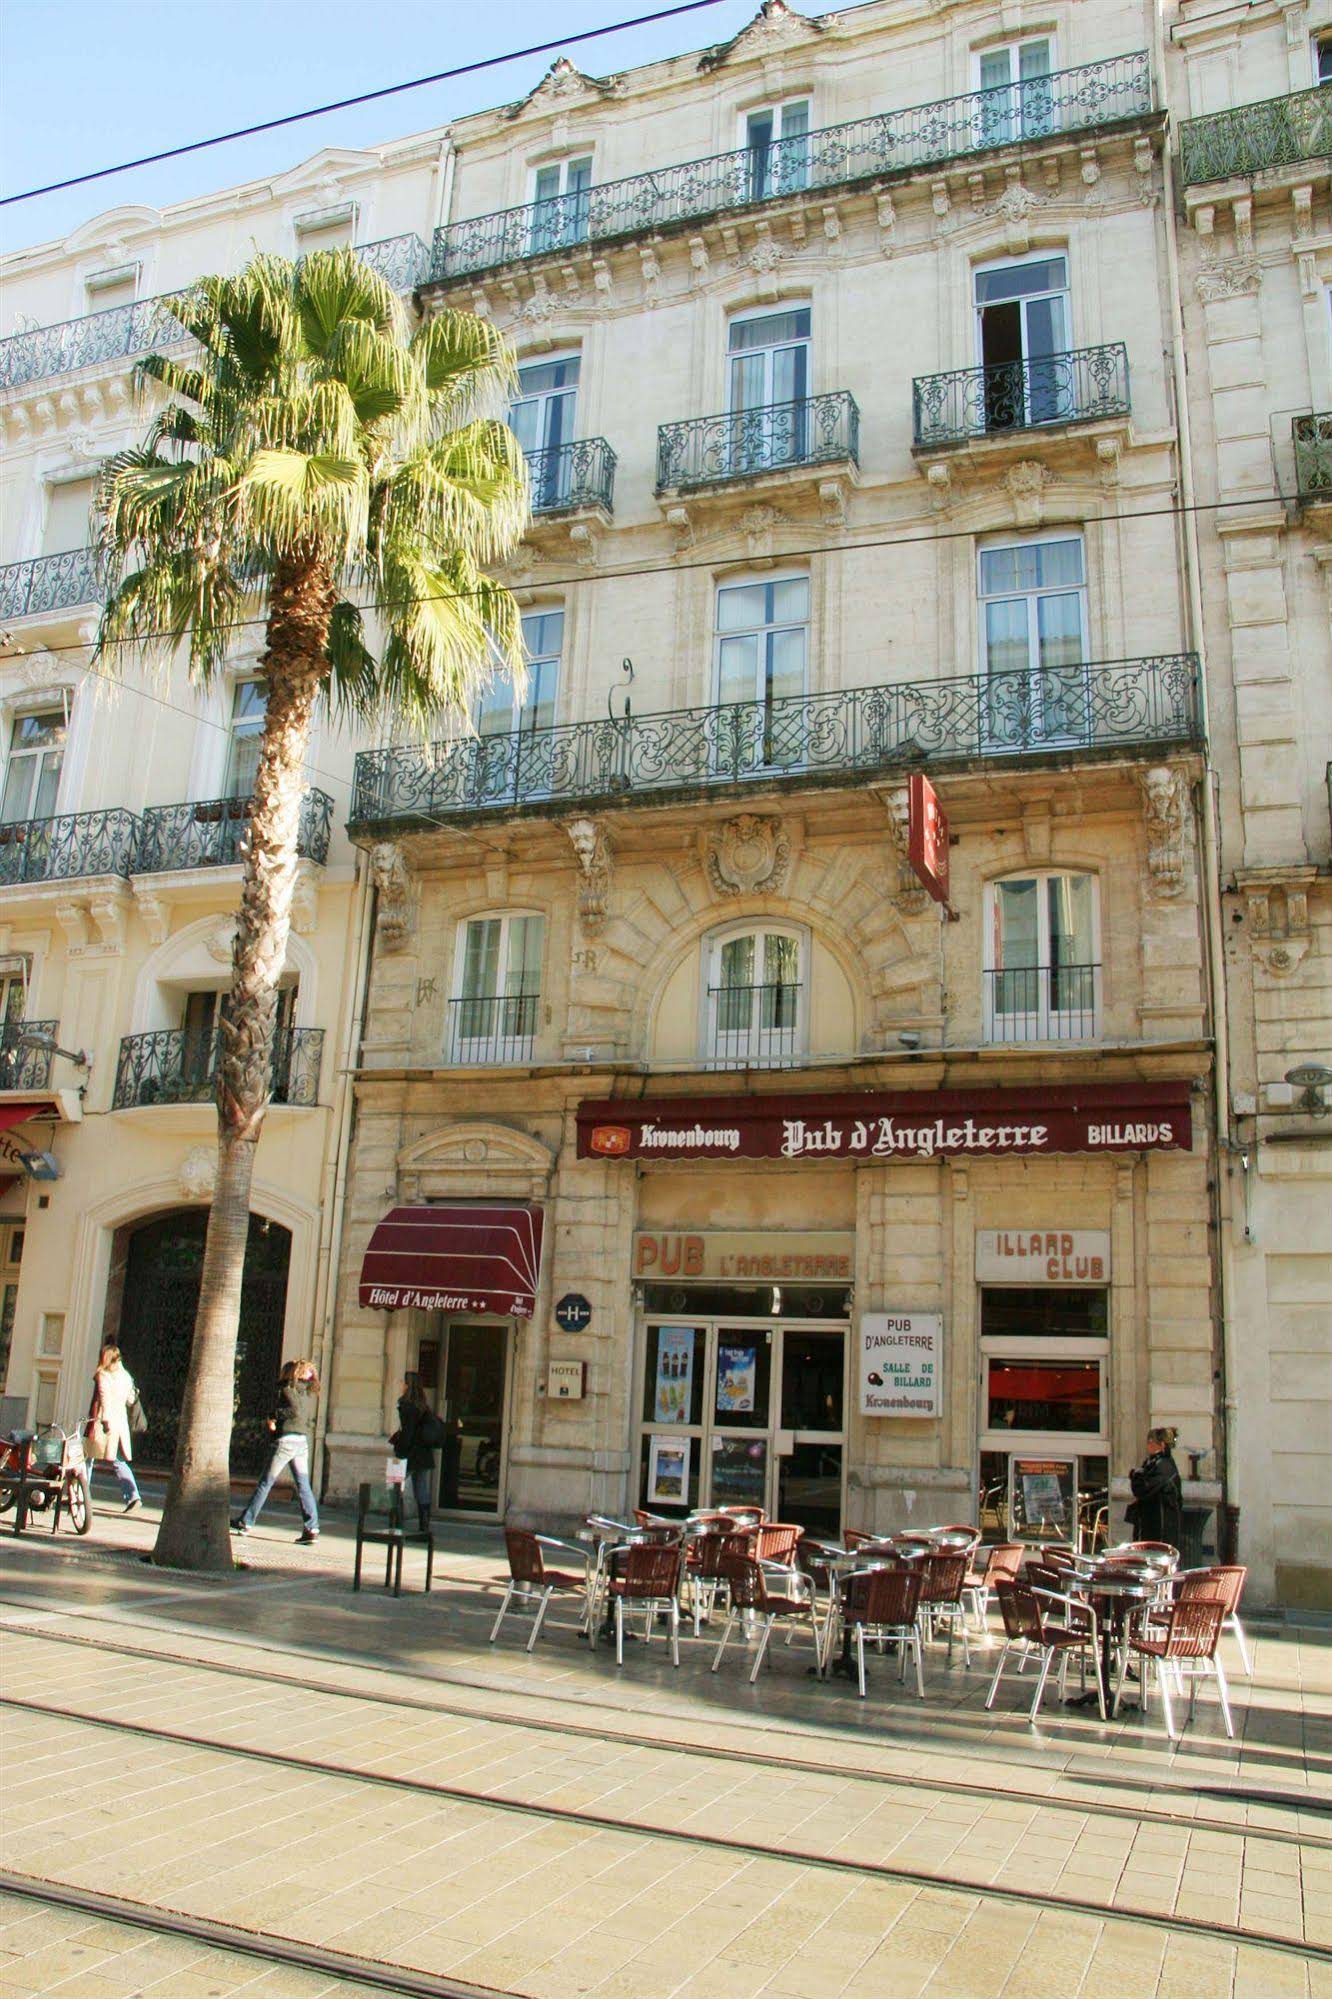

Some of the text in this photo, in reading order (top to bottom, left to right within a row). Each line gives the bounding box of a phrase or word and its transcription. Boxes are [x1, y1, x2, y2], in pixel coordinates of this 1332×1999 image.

[639, 1124, 740, 1150] Kronenbourg
[780, 1117, 1048, 1157] Pub d'Angleterre
[1087, 1123, 1173, 1145] BILLARDS
[637, 1236, 705, 1275] PUB
[1047, 1256, 1104, 1279] CLUB
[369, 1288, 468, 1310] Hôtel d'Angleterre
[887, 1319, 912, 1331] PUB
[865, 1335, 934, 1351] D'ANGLETERRE
[551, 1367, 580, 1376] HOTEL
[883, 1363, 934, 1373] SALLE DE
[894, 1377, 932, 1387] BILLARD
[865, 1394, 934, 1411] Kronenbourg
